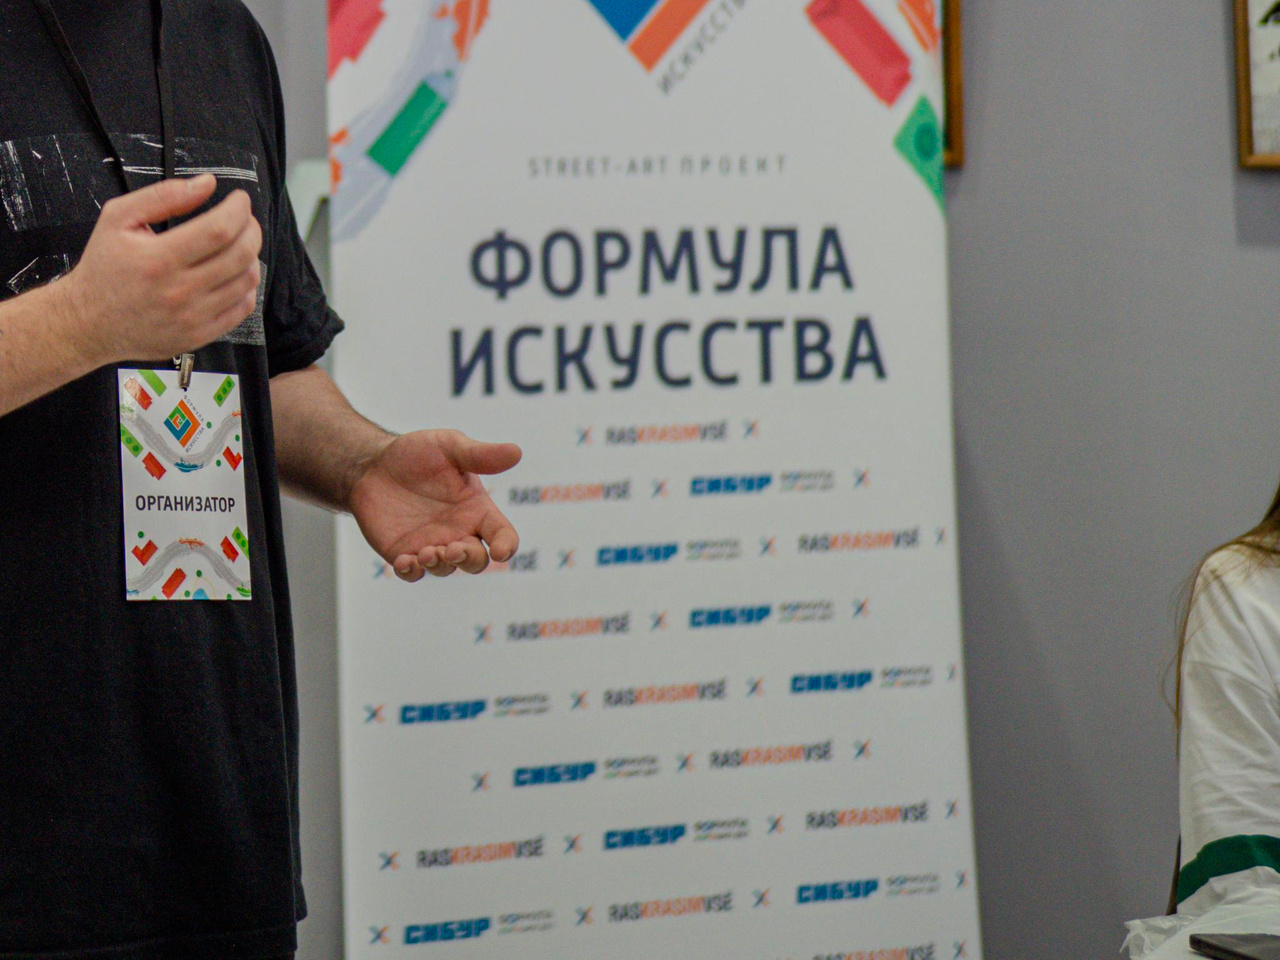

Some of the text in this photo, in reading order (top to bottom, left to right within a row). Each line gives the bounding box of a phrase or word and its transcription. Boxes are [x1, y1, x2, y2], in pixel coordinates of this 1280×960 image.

[528, 154, 788, 178] STREET-ART ПРОЕКТ
[469, 226, 855, 301] ФОРМУЛА
[450, 315, 888, 399] ИСКУССТВА
[690, 473, 772, 496] СИБУР
[135, 495, 236, 513] ОРГАНИЗАТОР
[596, 542, 679, 567] СИБУР
[689, 603, 771, 628] СИБУР
[790, 669, 873, 693] СИБУР
[399, 699, 487, 724] СИБУР
[513, 760, 596, 787] СИБУР
[603, 823, 686, 849] СИБУР
[796, 878, 879, 904] СИБУР
[403, 916, 491, 945] СИБУР
